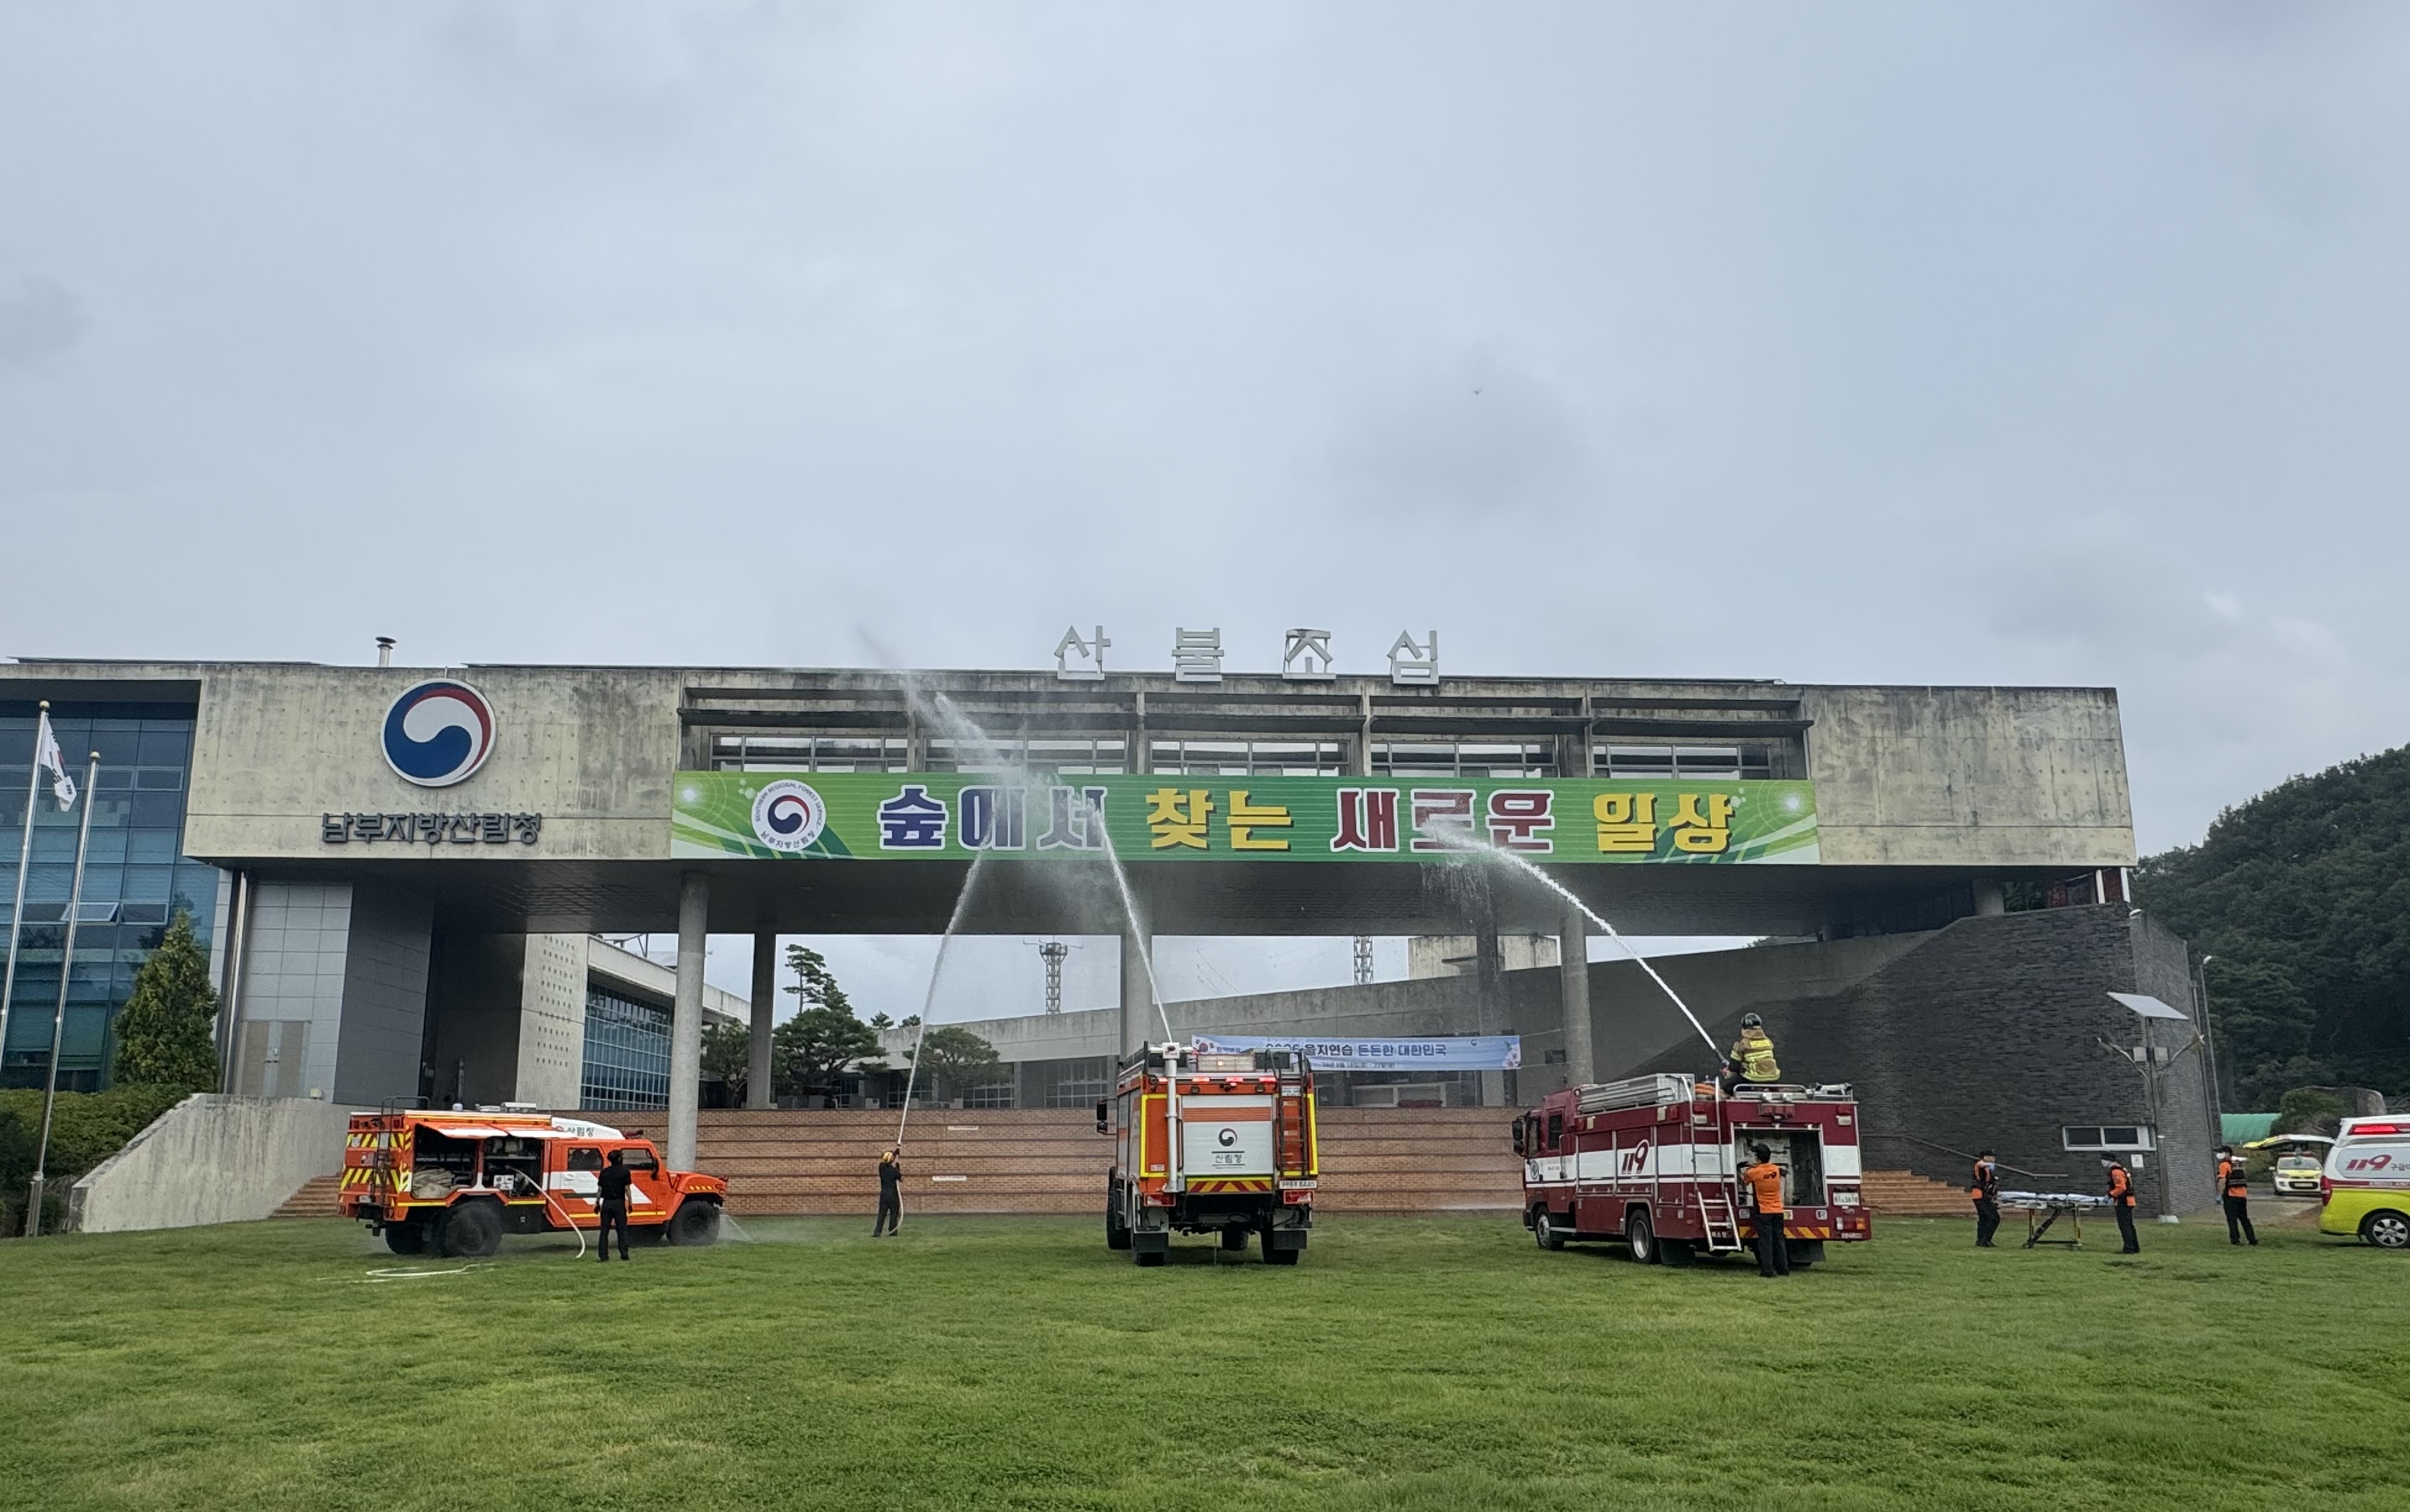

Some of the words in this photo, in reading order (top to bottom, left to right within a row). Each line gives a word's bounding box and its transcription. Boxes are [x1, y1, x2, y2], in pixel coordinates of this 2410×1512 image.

[1054, 625, 1439, 684] 산불조심
[322, 812, 542, 845] 남부지방산림청
[877, 785, 1107, 850] 숲에서
[1145, 787, 1293, 852] 찾는
[1330, 788, 1555, 853] 새로운
[1592, 792, 1735, 854] 일상
[1304, 1044, 1353, 1056] 을지연습
[1358, 1044, 1394, 1056] 든든한
[1398, 1044, 1446, 1057] 대한민국
[1215, 1154, 1242, 1164] 산림청
[1621, 1141, 1648, 1174] 119
[2345, 1154, 2392, 1170] 119
[1763, 1172, 1777, 1180] 119
